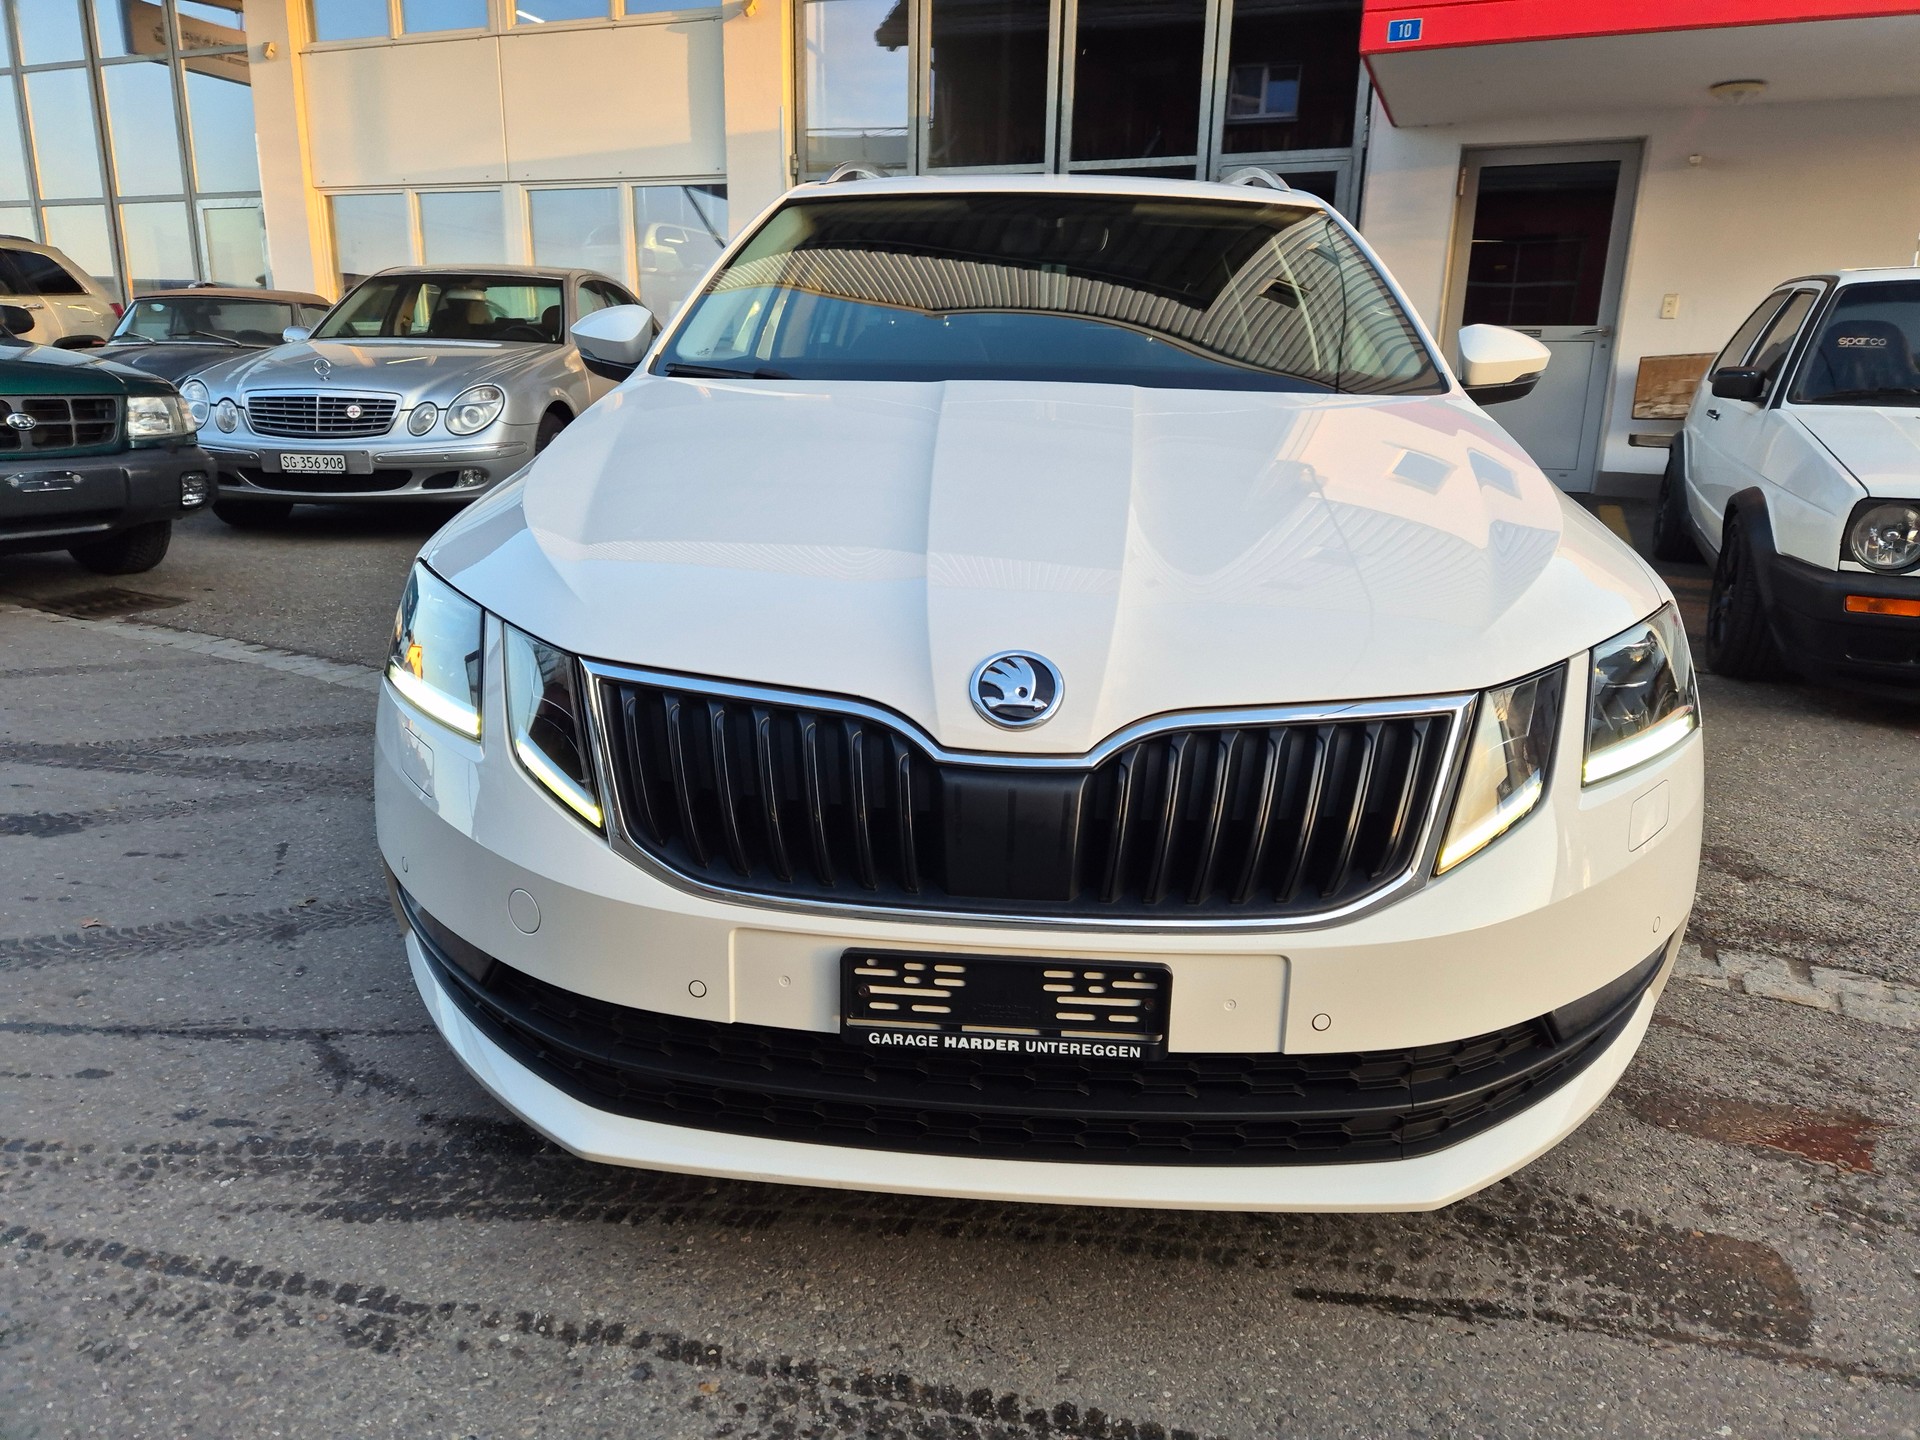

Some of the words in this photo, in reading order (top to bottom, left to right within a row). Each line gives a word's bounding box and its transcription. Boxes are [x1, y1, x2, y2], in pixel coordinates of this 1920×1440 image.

[1399, 23, 1412, 38] 10
[1837, 336, 1887, 348] sparco
[868, 1032, 939, 1048] GARAGE
[944, 1036, 1020, 1052] HARDER
[1025, 1041, 1141, 1058] UNTEREGGEN
